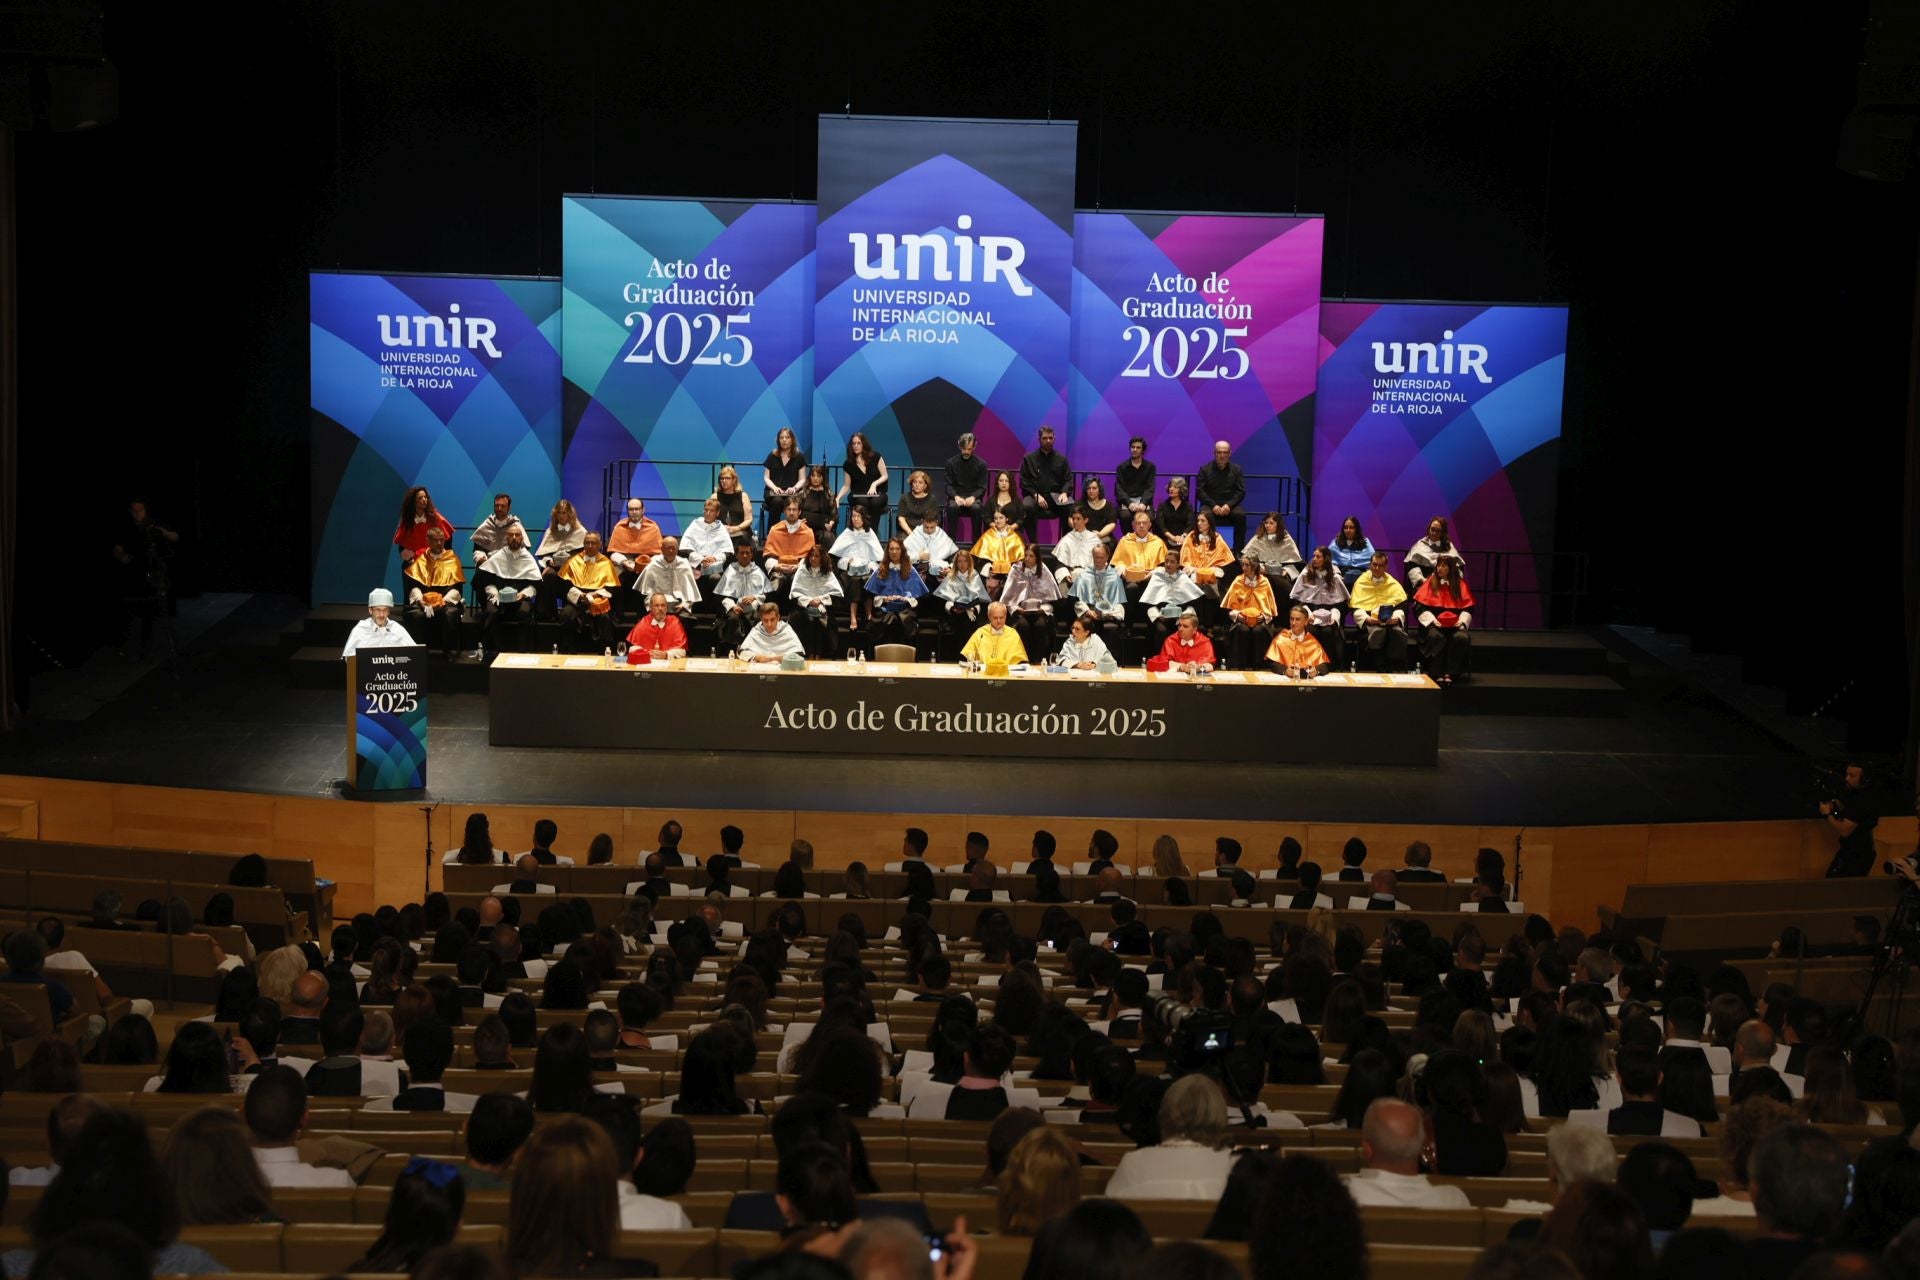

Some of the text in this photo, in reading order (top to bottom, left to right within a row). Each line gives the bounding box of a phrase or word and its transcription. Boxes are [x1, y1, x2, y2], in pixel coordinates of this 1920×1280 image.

[646, 258, 731, 281] Acto de
[1146, 271, 1230, 294] Acto de
[623, 282, 755, 307] Graduación
[853, 289, 970, 306] UNIVERSIDAD
[1122, 295, 1253, 320] Graduación
[853, 308, 995, 326] INTERNACIONAL
[623, 311, 754, 367] 2025
[852, 328, 959, 344] DE LA RIOJA
[381, 352, 461, 365] UNIVERSIDAD
[1121, 325, 1250, 380] 2025
[381, 364, 478, 378] INTERNACIONAL
[381, 377, 454, 389] DE LA RIOJA
[1373, 378, 1451, 390] UNIVERSIDAD
[1372, 390, 1467, 403] INTERNACIONAL
[1372, 403, 1443, 415] DE LA RIOJA
[374, 671, 408, 681] Acto de
[365, 680, 417, 691] Graduación
[365, 691, 418, 714] 2025
[764, 700, 1166, 737] Acto de Graduación 2025
